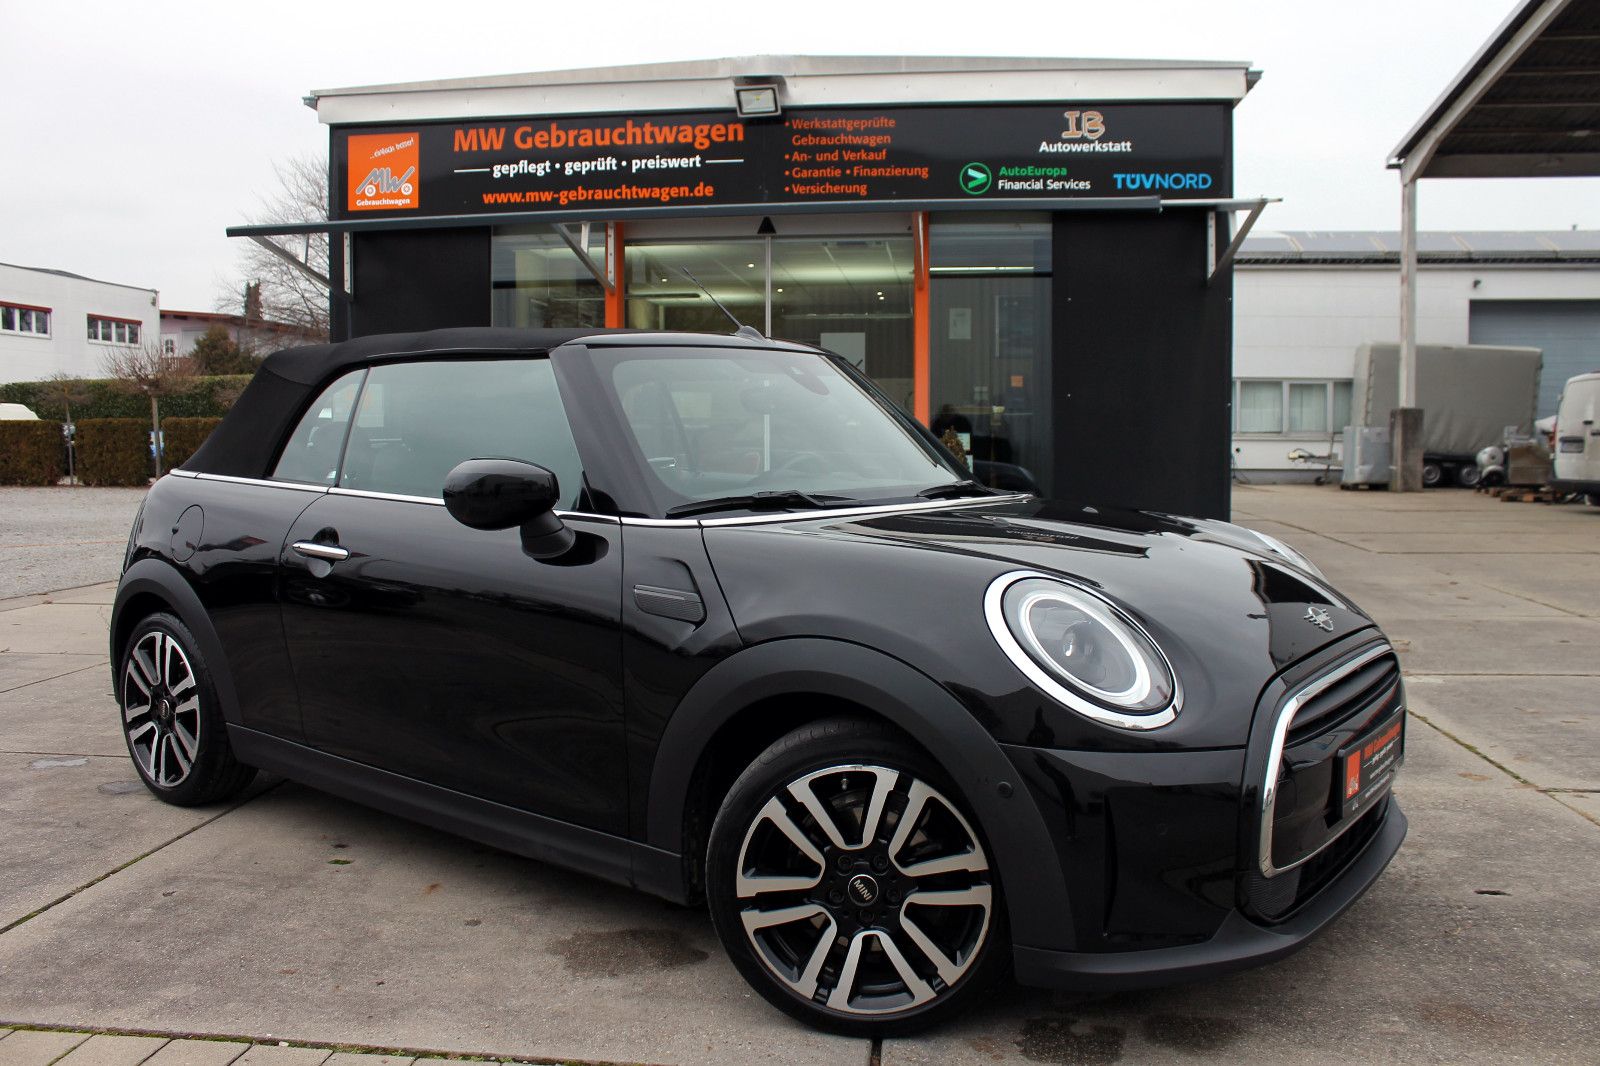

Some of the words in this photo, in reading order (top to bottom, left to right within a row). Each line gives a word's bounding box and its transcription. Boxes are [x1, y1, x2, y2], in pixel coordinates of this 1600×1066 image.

[791, 117, 896, 131] Werkstattgeprüfte
[453, 127, 506, 152] MW
[513, 120, 745, 150] Gebrauchtwagen
[791, 133, 891, 147] Gebrauchtwagen
[1038, 140, 1132, 153] Autowerkstatt
[791, 151, 812, 162] An-
[815, 150, 839, 161] und
[842, 148, 887, 160] Verkauf
[492, 160, 551, 178] gepflegt
[564, 157, 618, 175] geprüft
[631, 154, 702, 173] preiswert
[791, 166, 842, 178] Garantie
[852, 165, 929, 179] Finanzierung
[999, 166, 1068, 178] AutoEuropa
[791, 182, 868, 196] Versicherung
[998, 179, 1044, 190] Financial
[1046, 178, 1091, 190] Services
[482, 181, 715, 206] www.mw-gebrauchtwagen.de
[355, 198, 411, 207] Gebrauchtwagen
[853, 879, 873, 901] MINI
